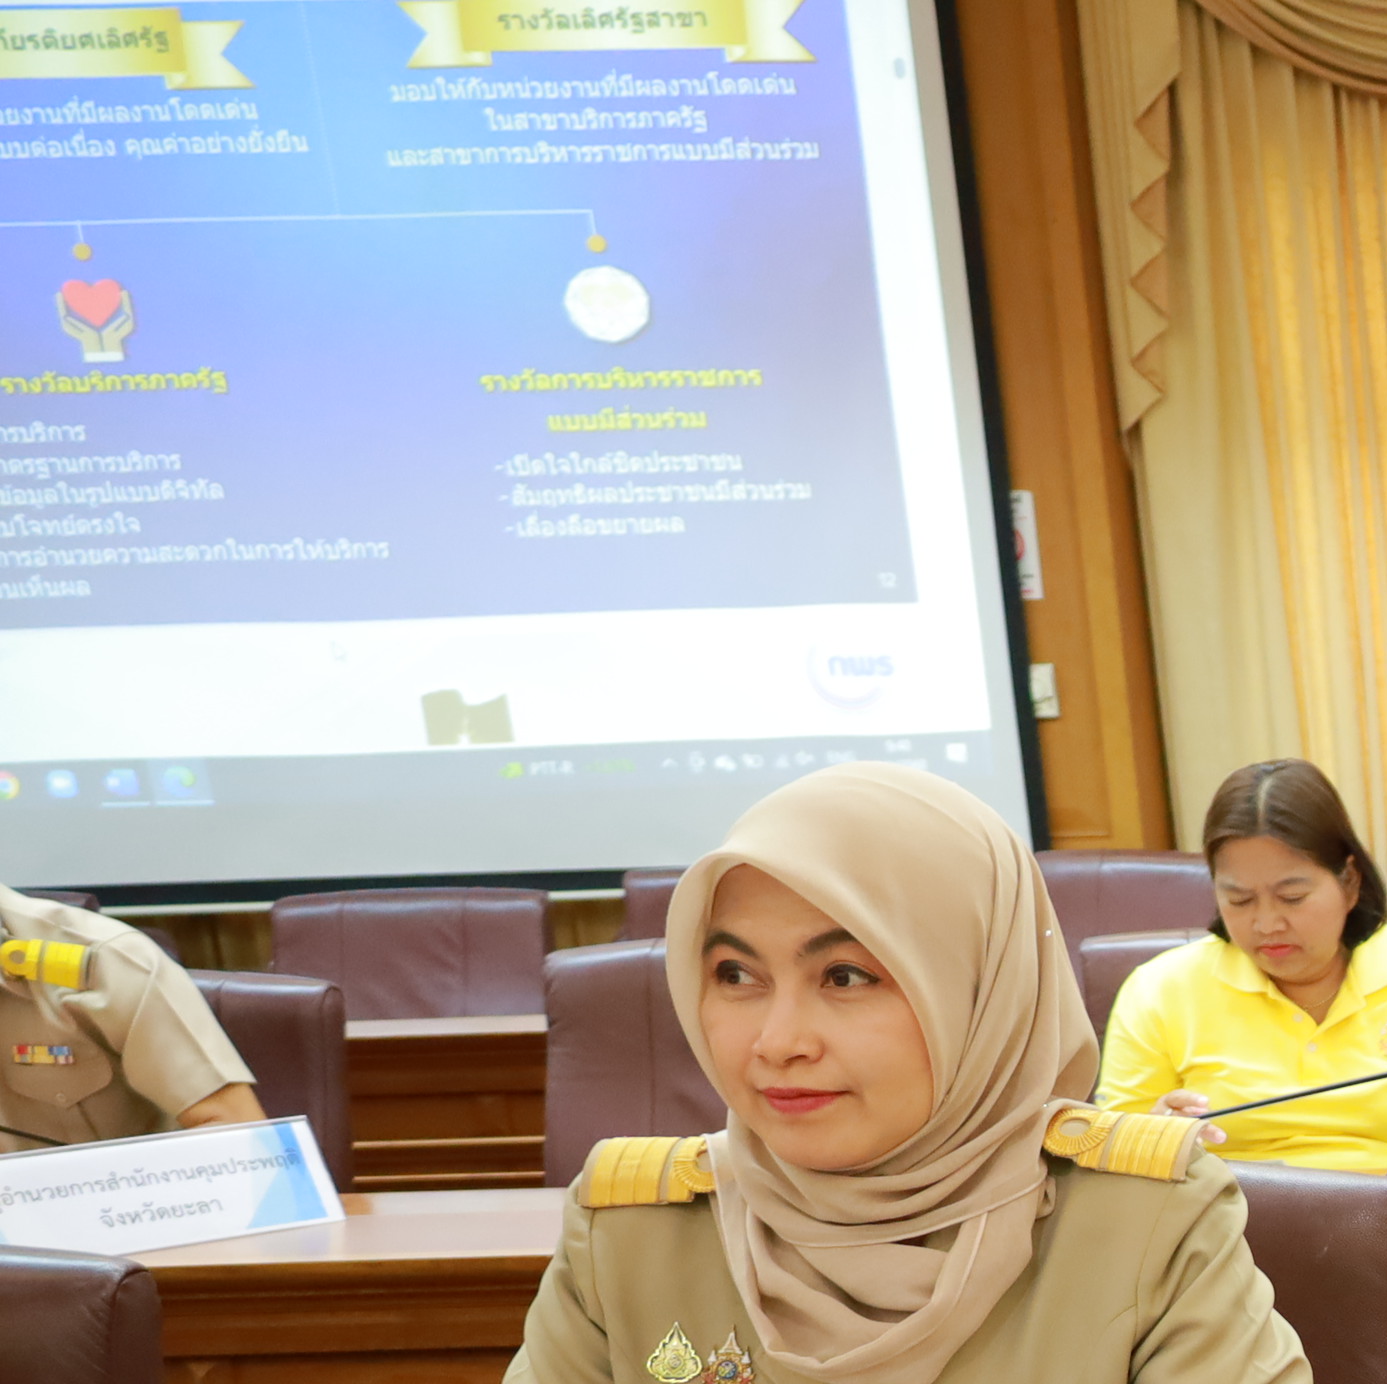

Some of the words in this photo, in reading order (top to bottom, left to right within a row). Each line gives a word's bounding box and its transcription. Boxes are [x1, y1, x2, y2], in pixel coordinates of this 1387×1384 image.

[99, 1196, 223, 1229] จังหวัดยะลา
